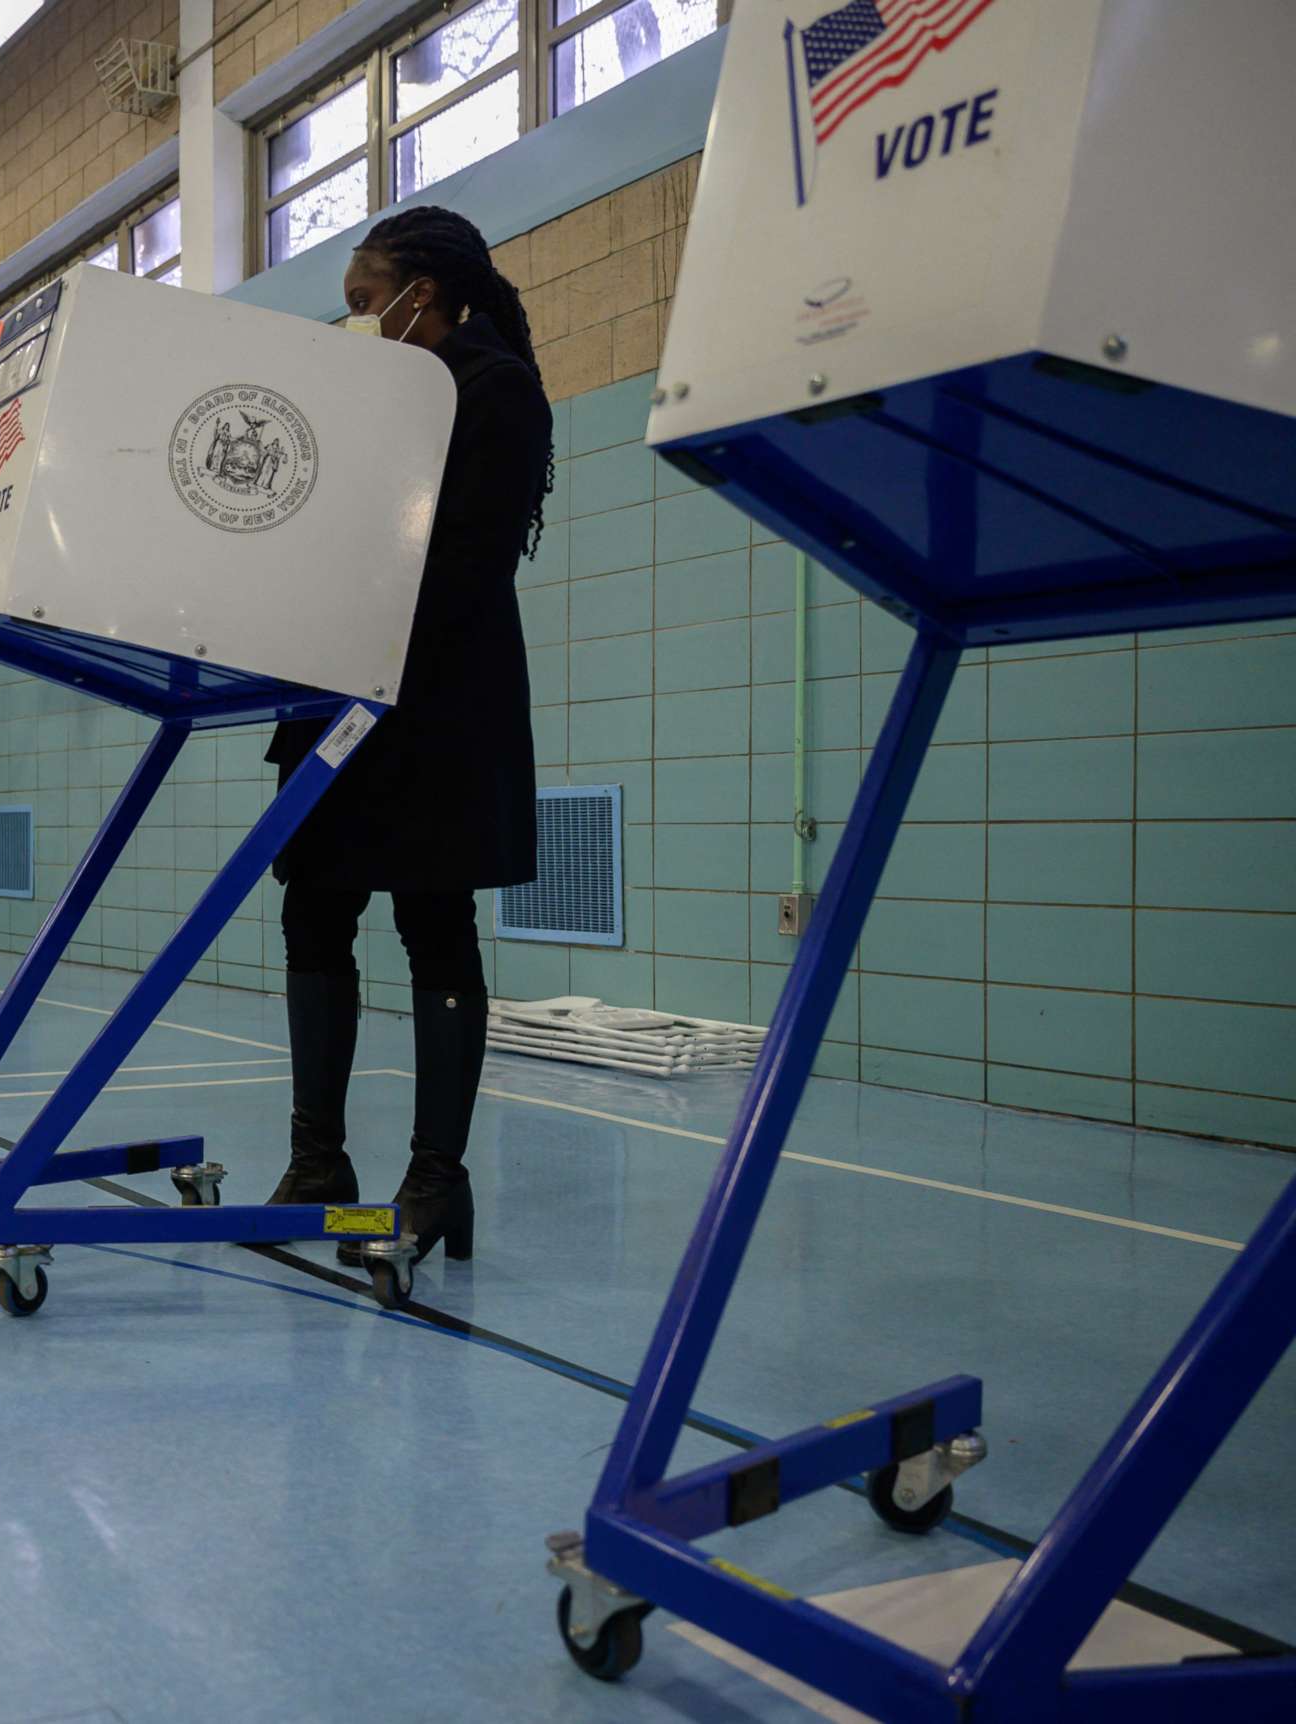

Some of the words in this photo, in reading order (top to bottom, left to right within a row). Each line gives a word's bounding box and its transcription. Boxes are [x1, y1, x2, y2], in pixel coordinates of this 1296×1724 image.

[874, 88, 1000, 180] VOTE
[188, 391, 234, 425] BOARD
[238, 391, 257, 401] OF
[261, 394, 312, 462] ELECTIONS
[176, 438, 188, 454] IN
[175, 458, 192, 487] THE
[187, 489, 218, 517] CITY
[277, 478, 308, 512] YORK
[219, 512, 239, 524] OF
[243, 509, 276, 526] NEW
